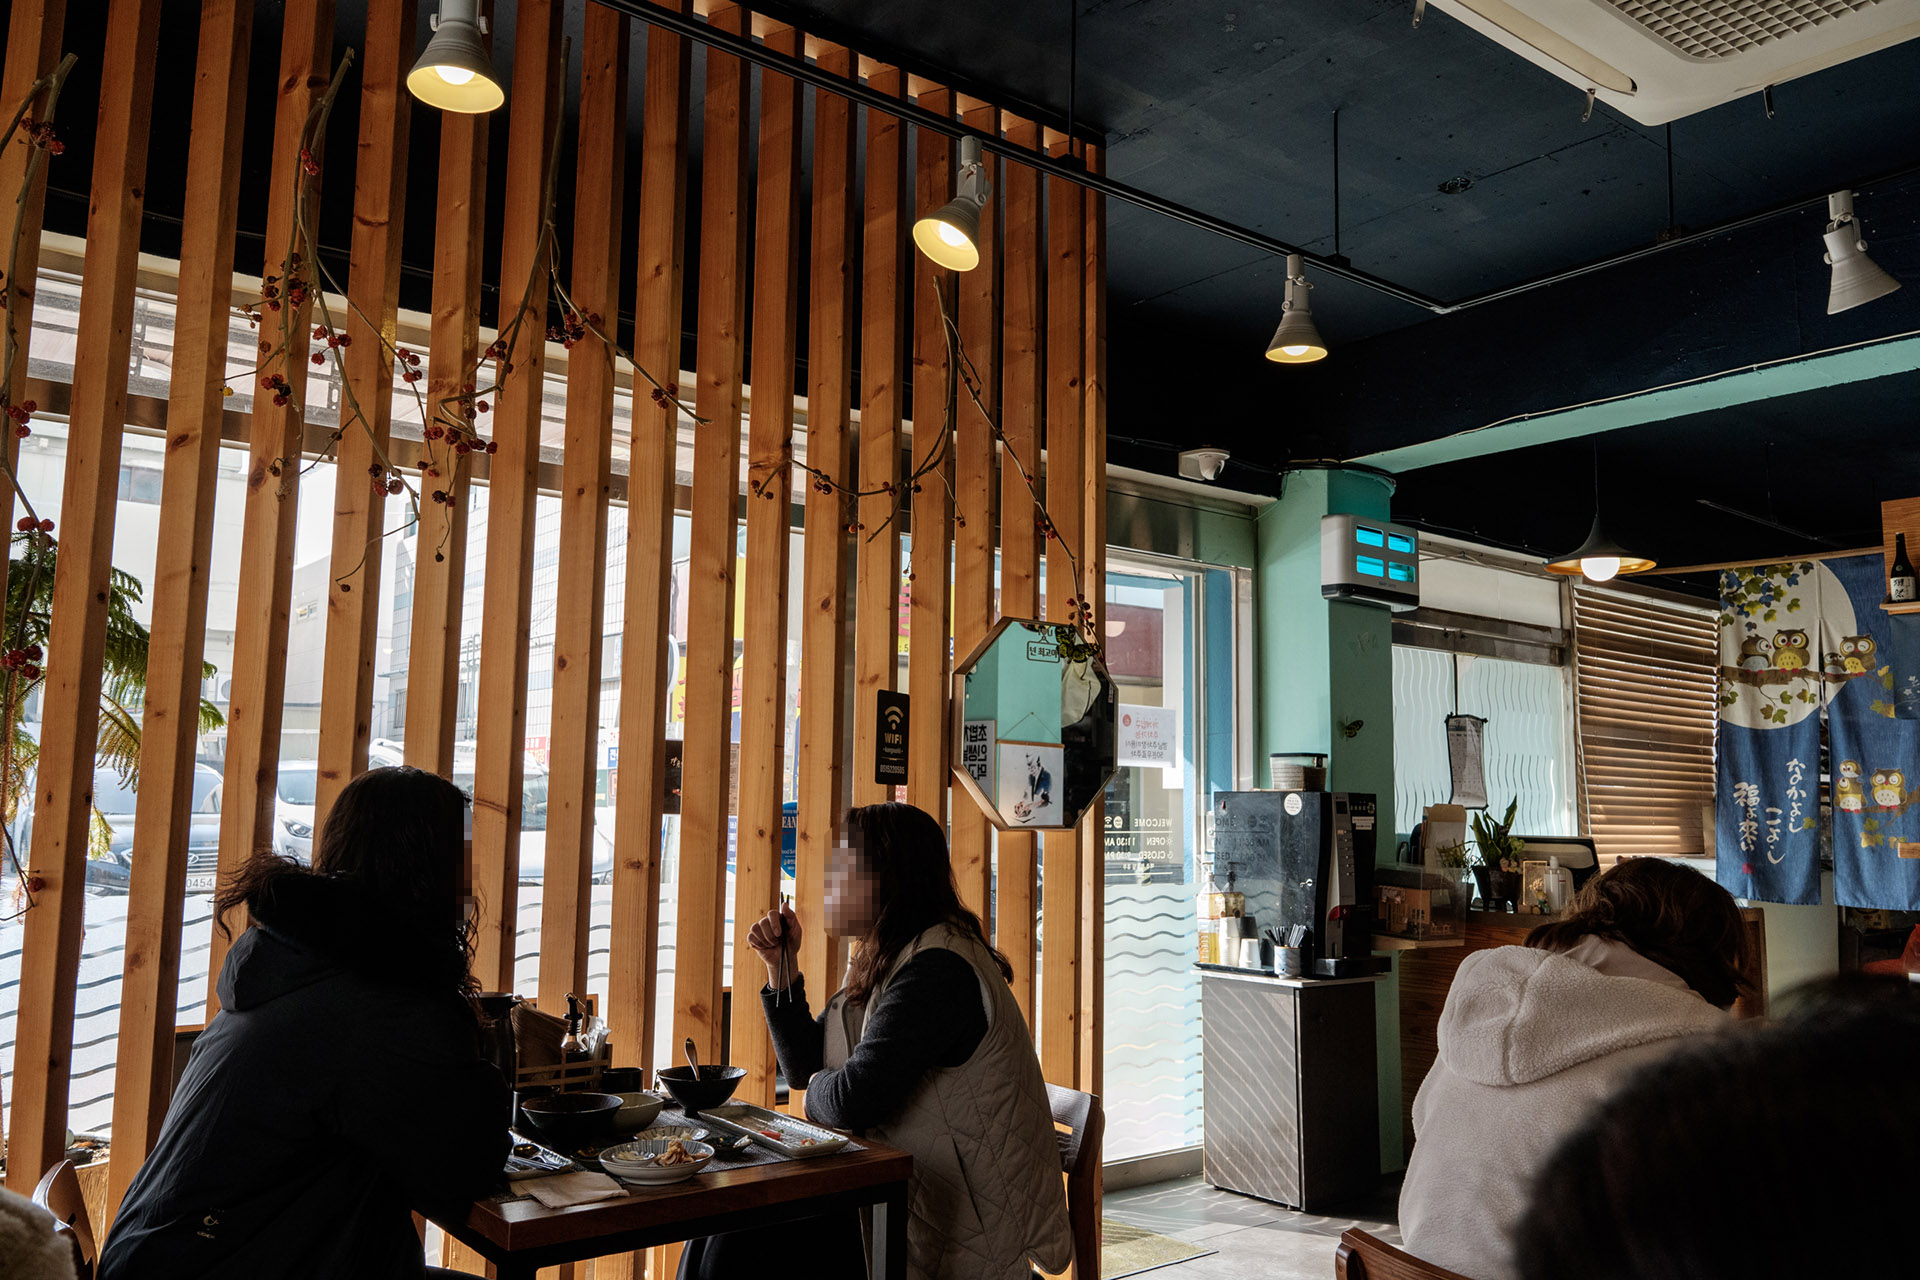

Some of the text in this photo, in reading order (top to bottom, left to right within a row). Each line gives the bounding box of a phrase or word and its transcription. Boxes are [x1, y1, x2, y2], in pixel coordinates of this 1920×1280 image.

[884, 731, 903, 745] WIFI
[1786, 757, 1807, 833] なかよし
[1765, 807, 1786, 865] こよし
[187, 878, 212, 888] 0454
